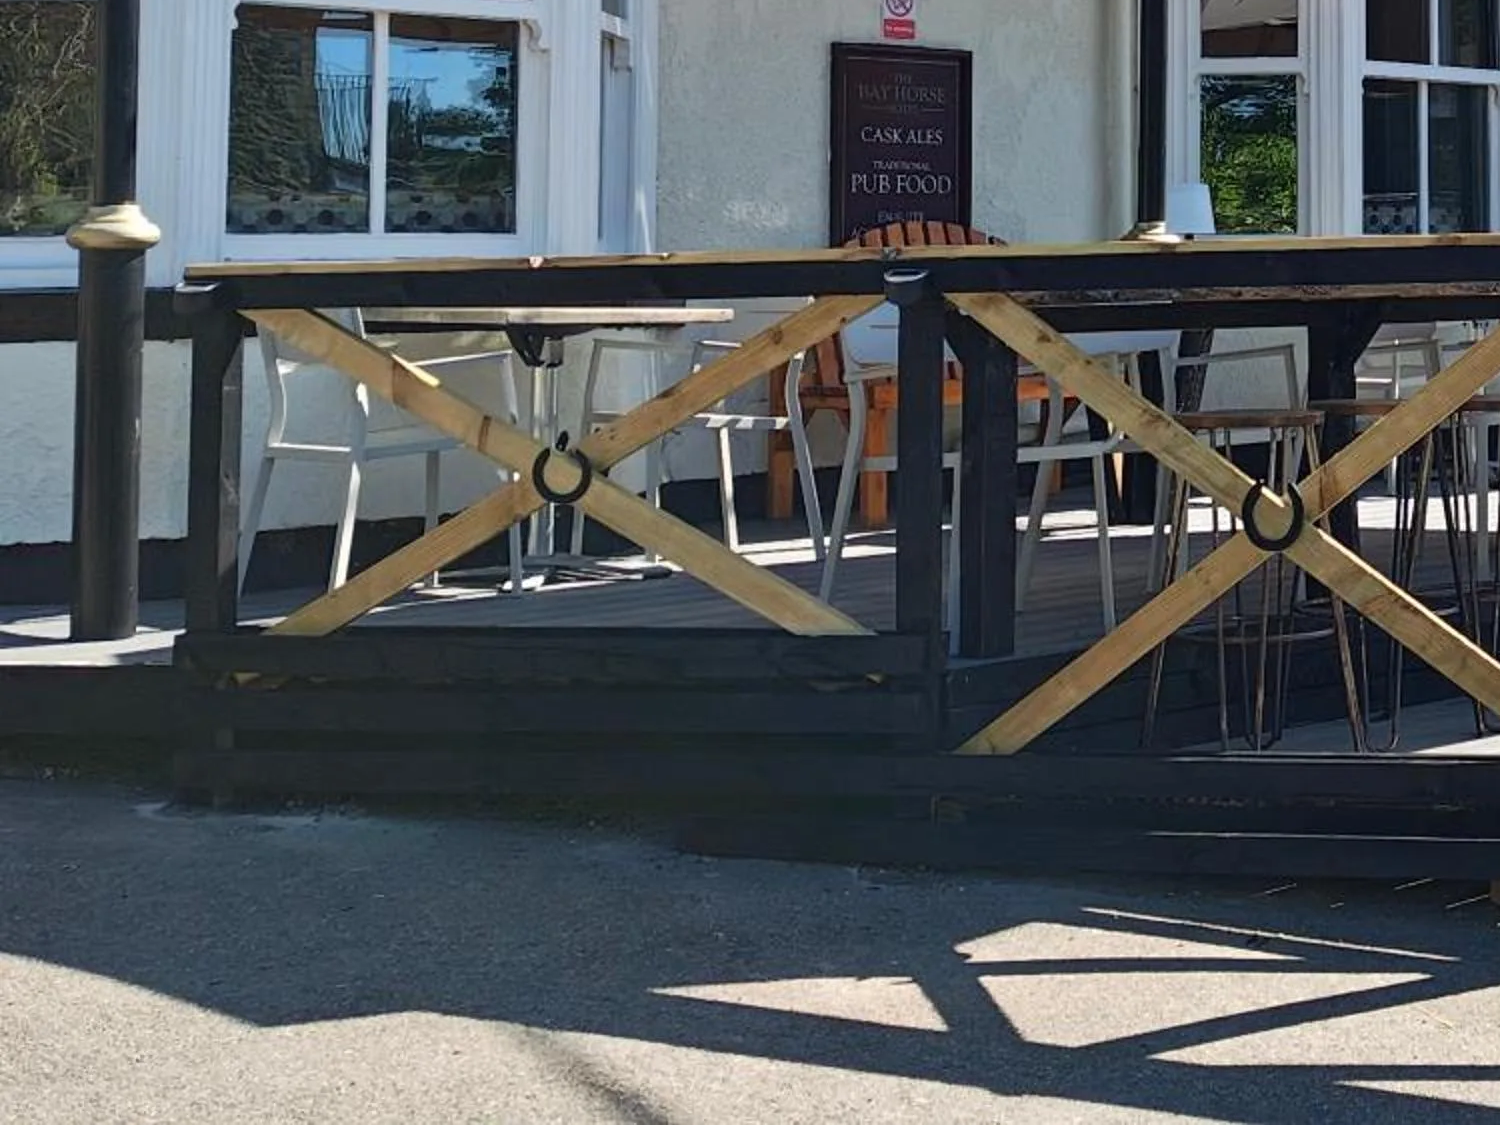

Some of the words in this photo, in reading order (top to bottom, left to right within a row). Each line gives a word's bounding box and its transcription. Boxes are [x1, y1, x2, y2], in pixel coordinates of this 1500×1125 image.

[858, 82, 891, 101] BAY
[894, 84, 945, 104] HORSE
[861, 126, 903, 144] CASK
[905, 128, 944, 147] ALES
[851, 173, 892, 194] PUB
[895, 174, 952, 194] FOOD
